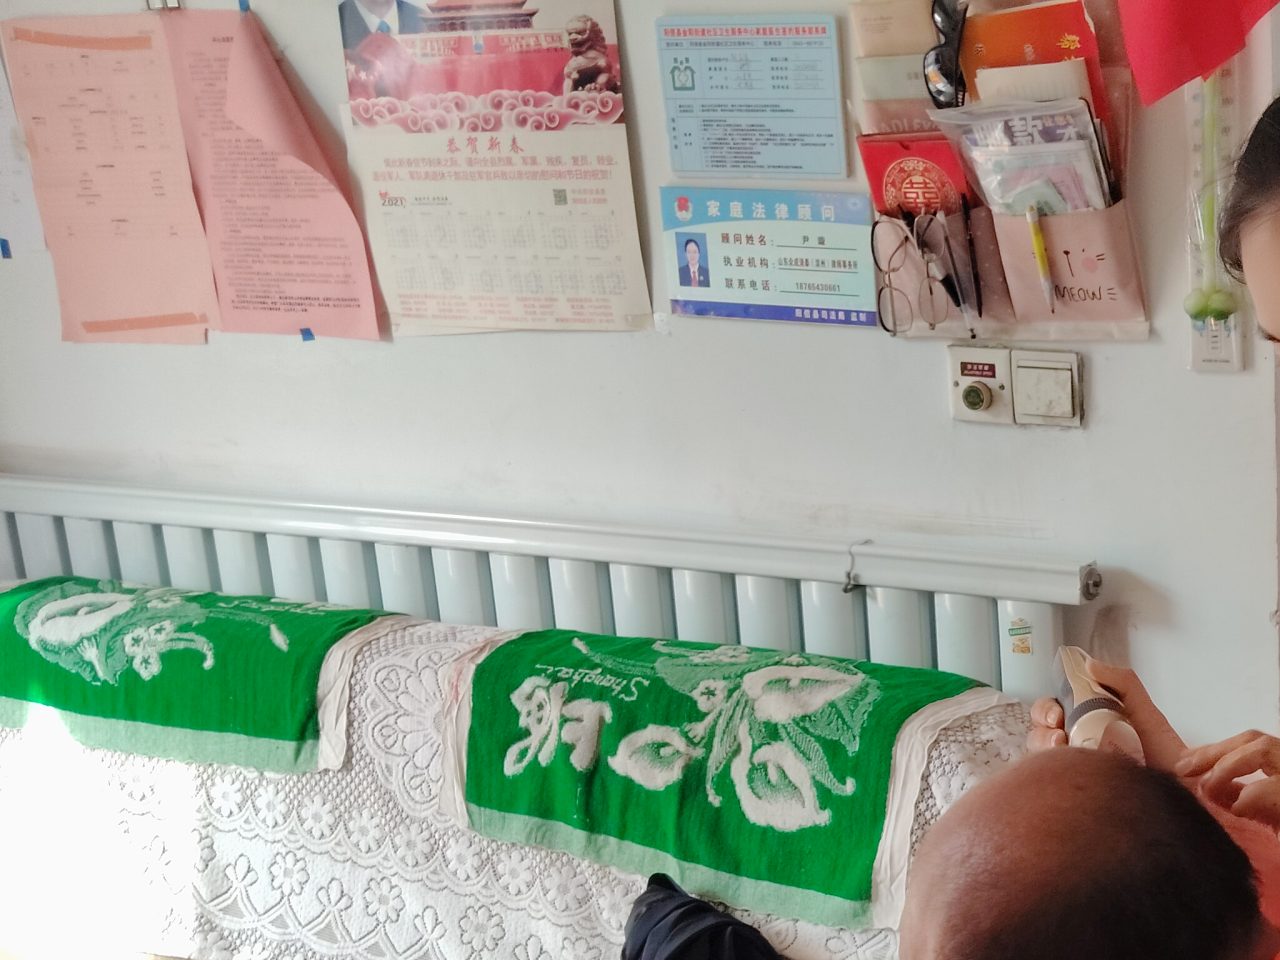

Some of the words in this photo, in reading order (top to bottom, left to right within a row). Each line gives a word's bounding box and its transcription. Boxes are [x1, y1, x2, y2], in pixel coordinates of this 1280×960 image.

[446, 135, 526, 154] 恭贺新春
[706, 200, 836, 222] 家庭法律顾问
[1054, 285, 1102, 302] MEOW
[535, 663, 651, 702] Shanghai
